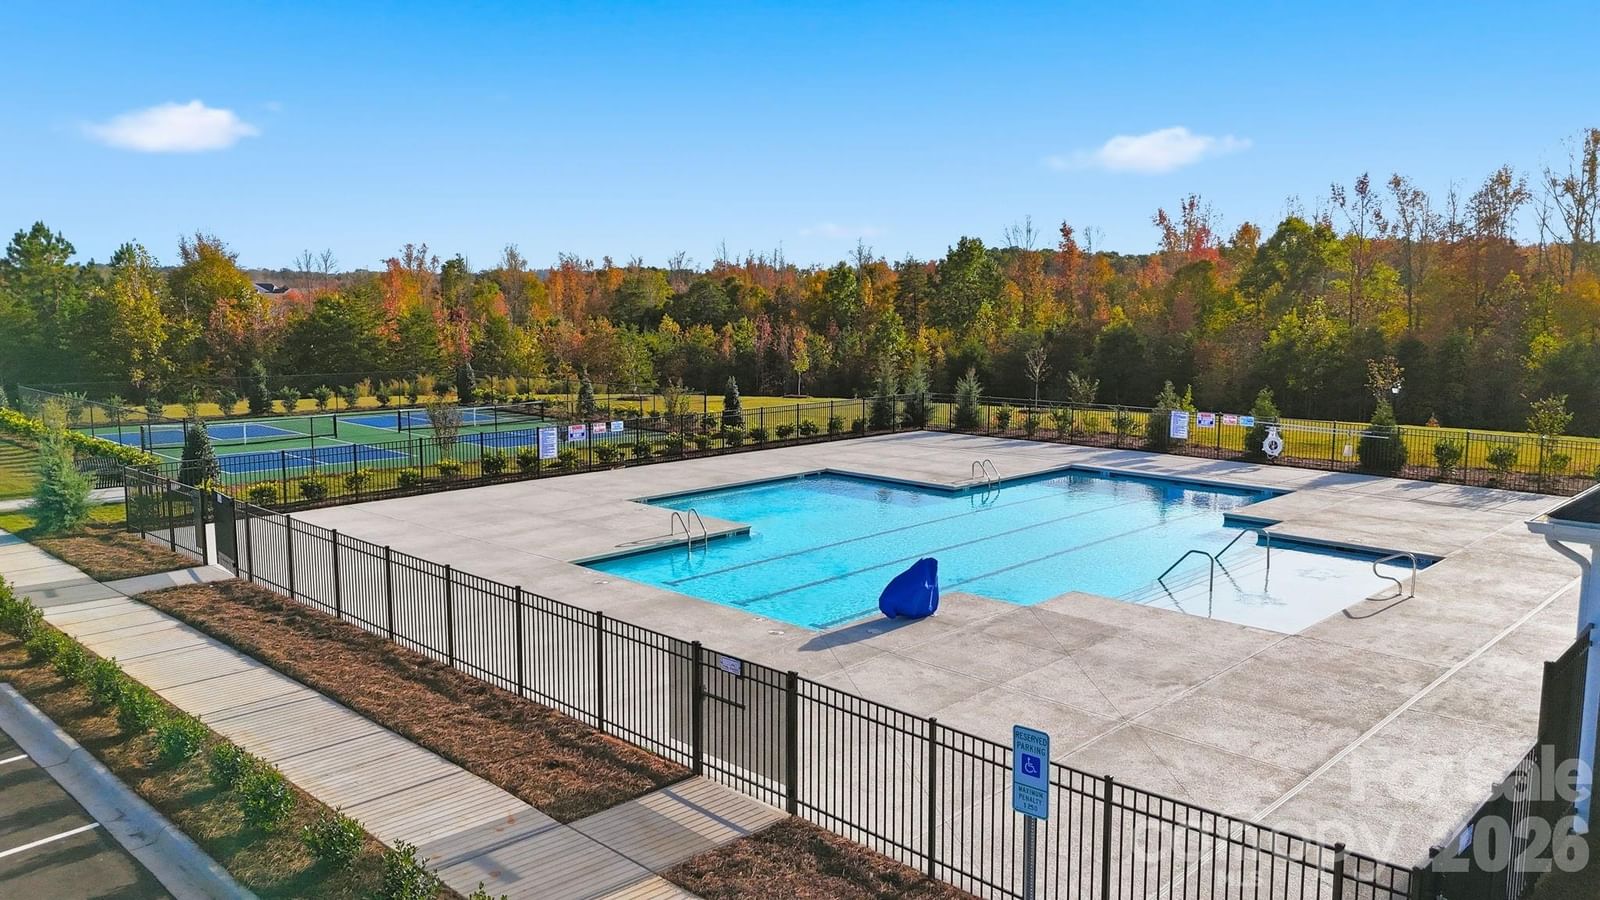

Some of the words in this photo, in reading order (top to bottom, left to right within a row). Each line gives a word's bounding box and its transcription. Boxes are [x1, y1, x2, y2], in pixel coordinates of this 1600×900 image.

[1015, 730, 1047, 746] RESERVED
[1016, 741, 1046, 757] PARKING
[1018, 785, 1043, 798] MAXIMUM
[1018, 793, 1042, 806] PENALTY
